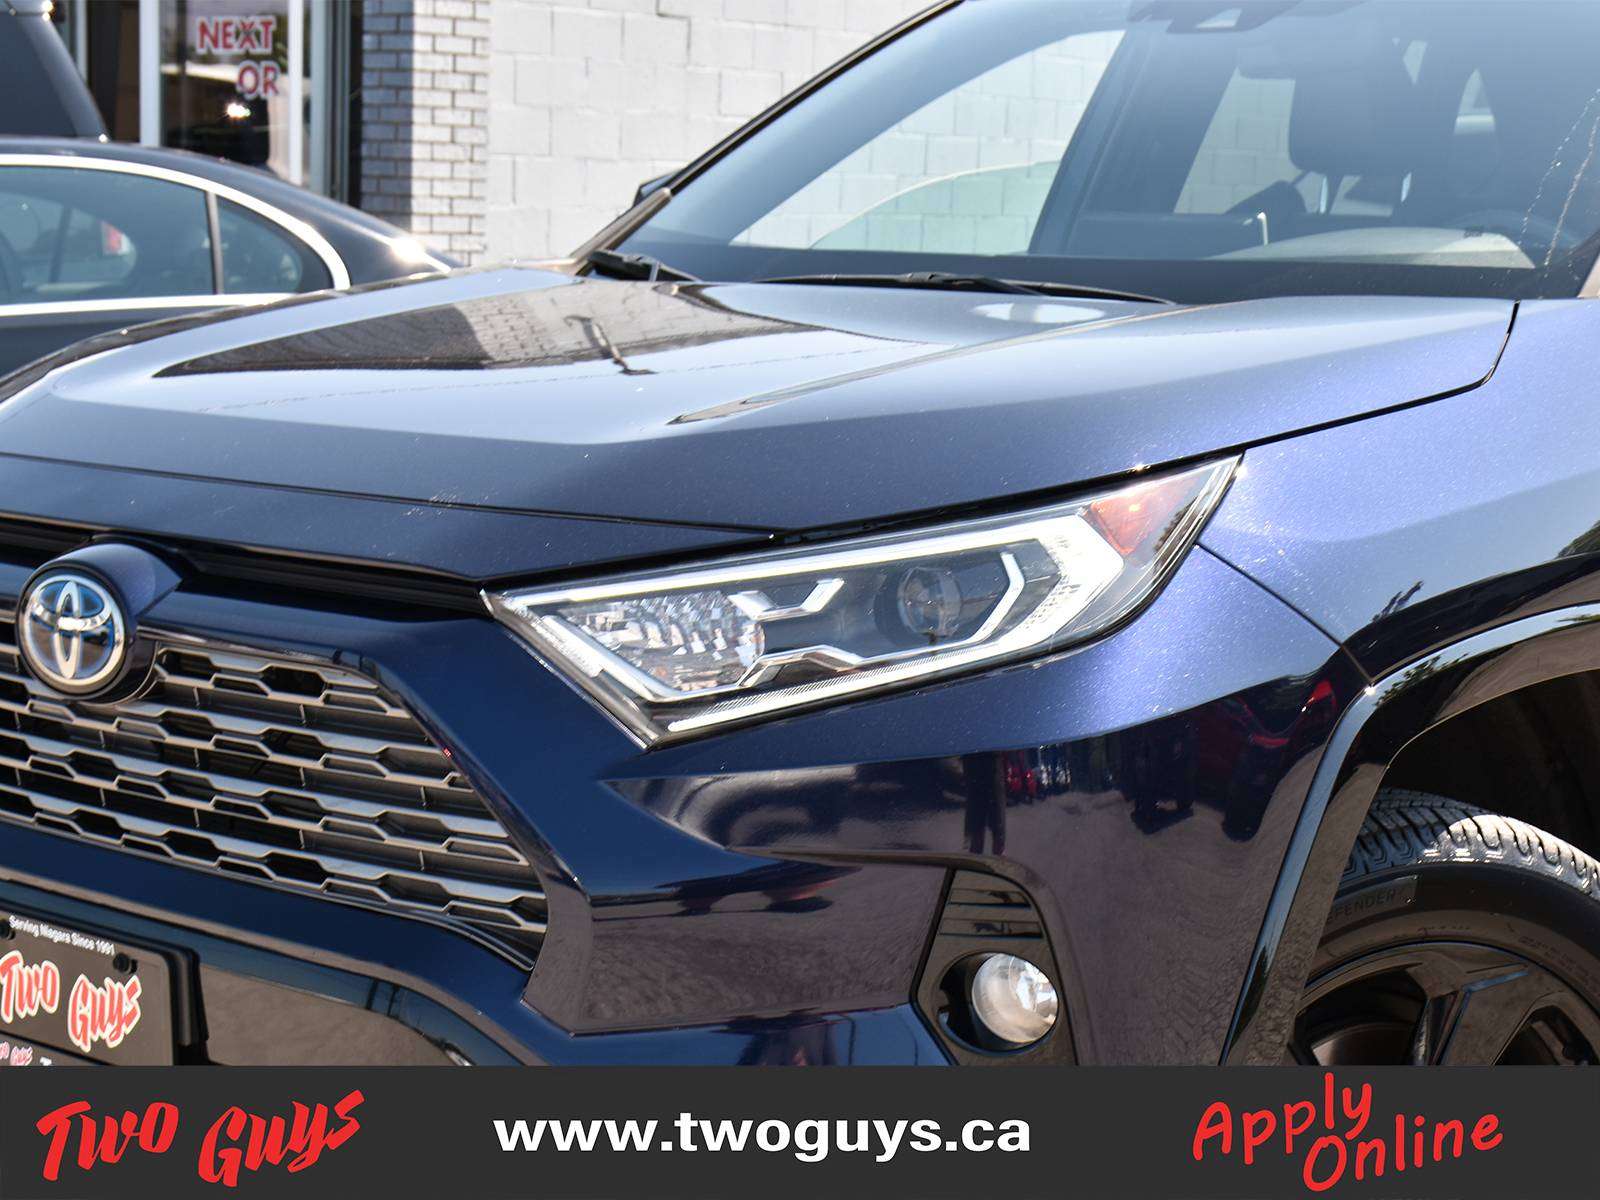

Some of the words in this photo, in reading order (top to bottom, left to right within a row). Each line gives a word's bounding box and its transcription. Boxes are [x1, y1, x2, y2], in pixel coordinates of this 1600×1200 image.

[196, 17, 275, 52] NEXT
[237, 62, 280, 98] OR
[1326, 887, 1396, 924] EFENDER
[9, 915, 40, 938] Serving
[71, 932, 96, 951] Since
